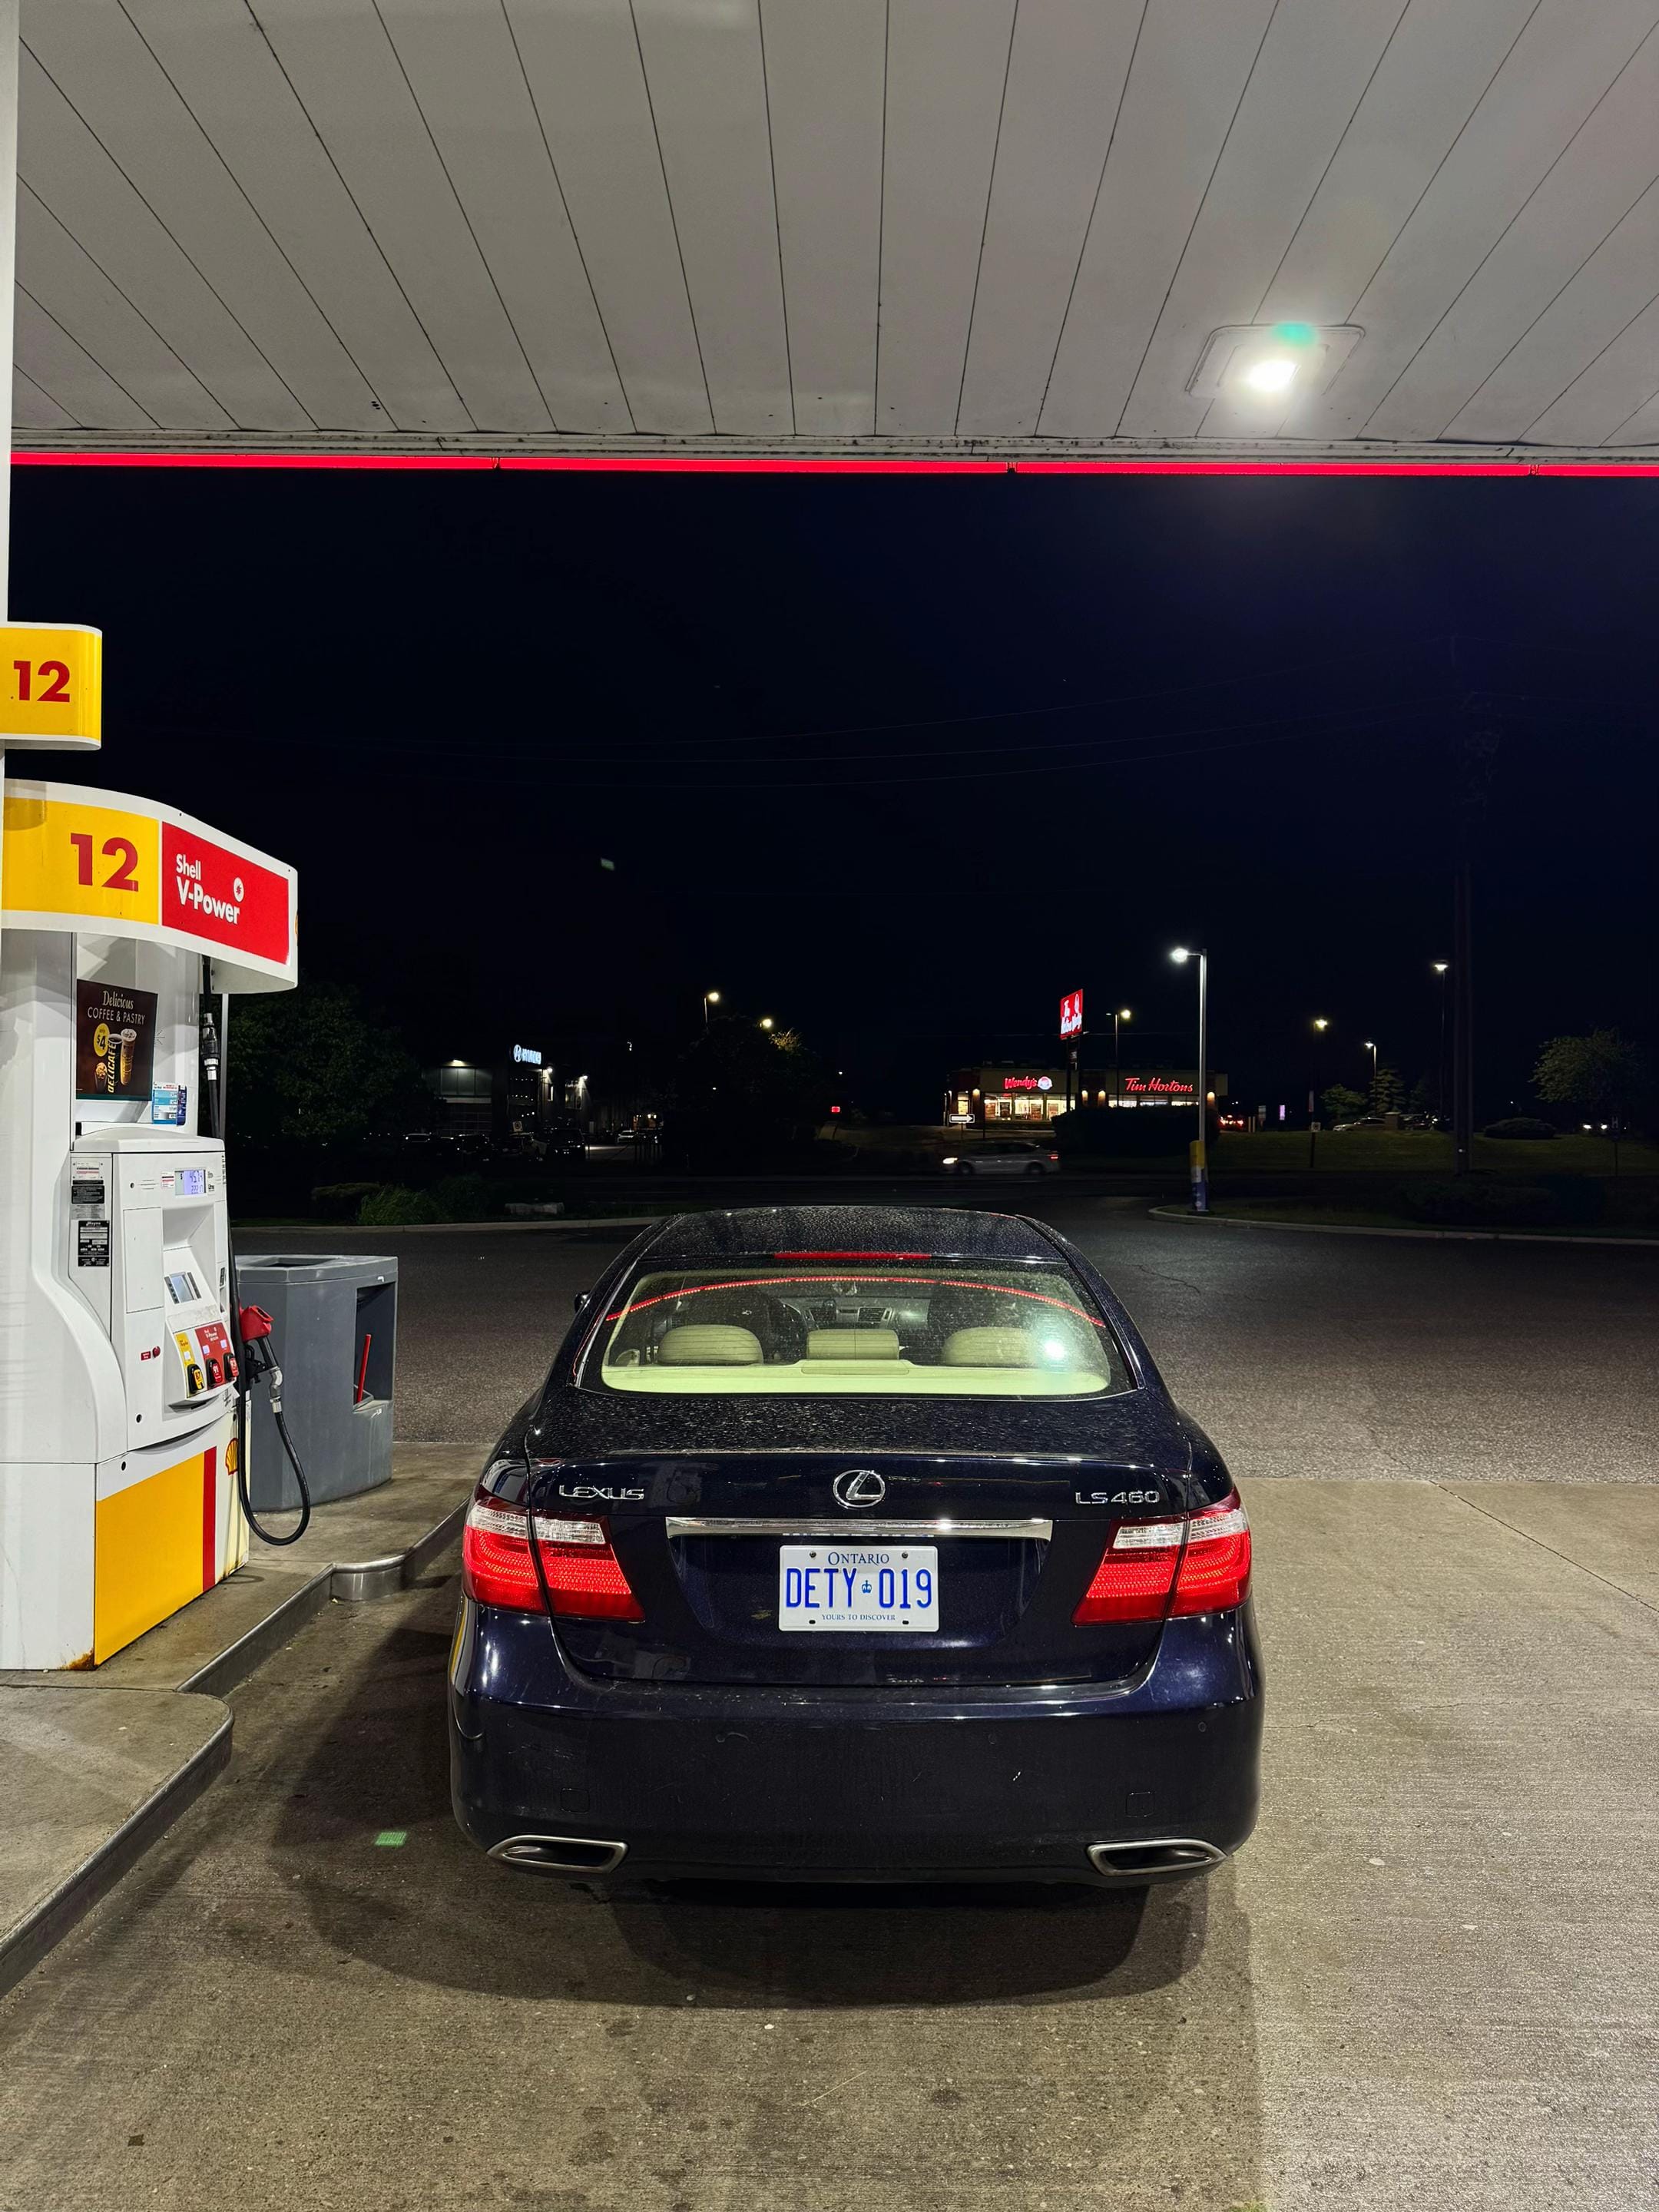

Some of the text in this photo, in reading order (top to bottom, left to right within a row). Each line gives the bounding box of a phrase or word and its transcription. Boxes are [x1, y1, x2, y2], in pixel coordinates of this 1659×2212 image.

[13, 661, 71, 703] 12
[71, 833, 139, 892] 12
[176, 853, 201, 881] Shell
[176, 876, 240, 925] V-Power
[102, 990, 134, 1009] Delicious
[87, 1006, 146, 1025] COFFEE & PASTRY
[97, 1035, 106, 1050] $4
[1005, 1076, 1038, 1090] Wendy's
[1125, 1077, 1194, 1092] Tim Hortons
[559, 1485, 644, 1500] LEXUS
[1075, 1490, 1160, 1505] LS 460
[828, 1551, 889, 1566] ONTARIO
[786, 1568, 932, 1609] DETY 019
